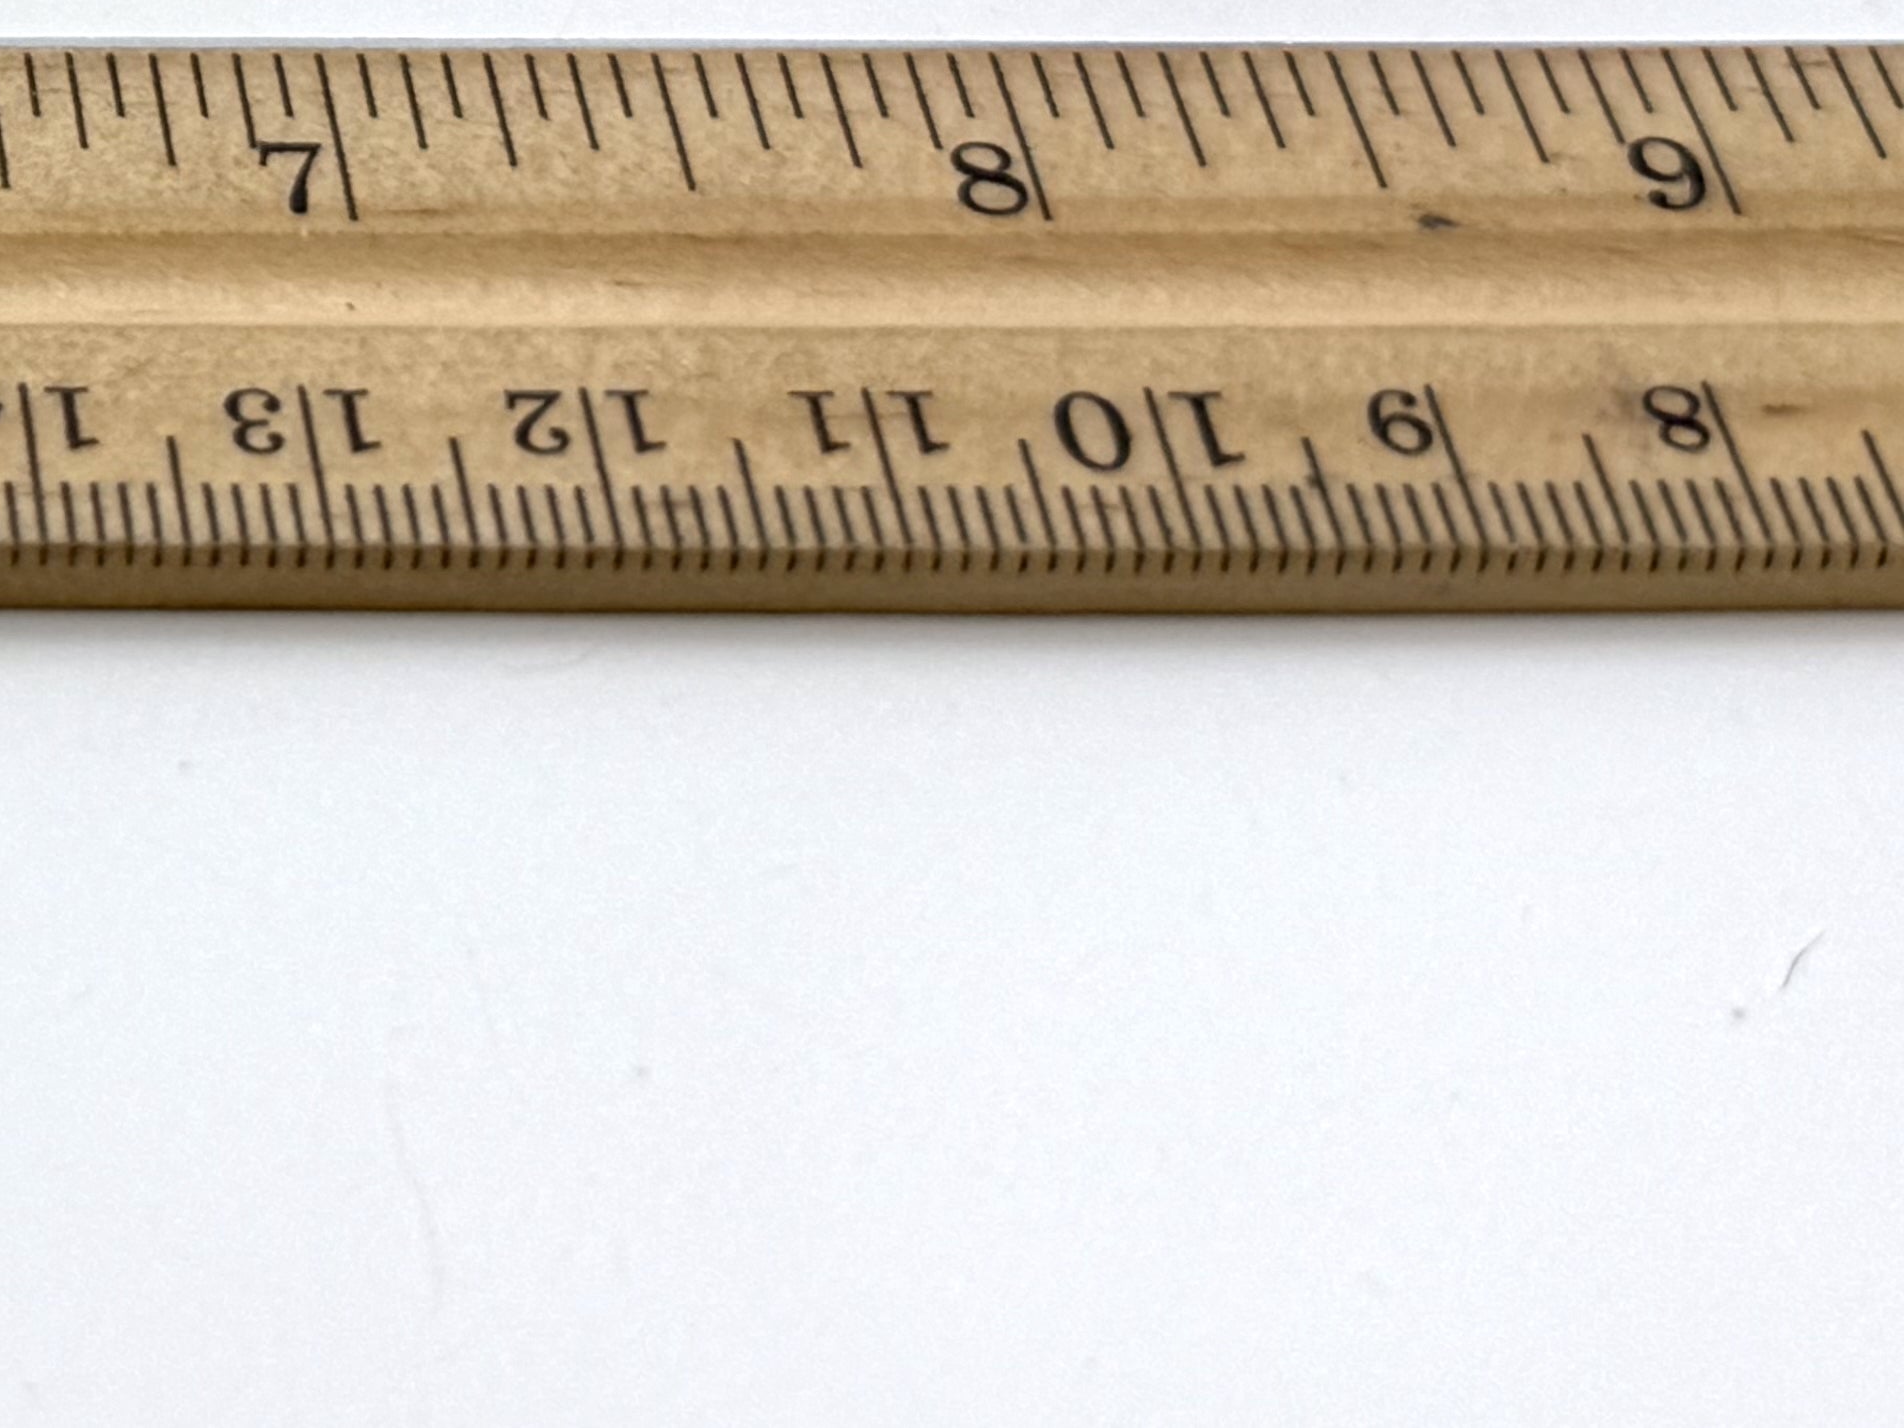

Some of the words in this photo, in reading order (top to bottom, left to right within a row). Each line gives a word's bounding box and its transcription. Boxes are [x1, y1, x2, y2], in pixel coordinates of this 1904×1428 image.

[258, 142, 322, 214] 7
[949, 142, 1030, 217] 8
[1626, 136, 1708, 212] 9
[223, 387, 382, 455] 13
[503, 389, 667, 456] 12
[787, 389, 950, 456] 11
[1053, 390, 1246, 472] 10
[1366, 388, 1434, 456] 9
[1641, 384, 1712, 455] 8
